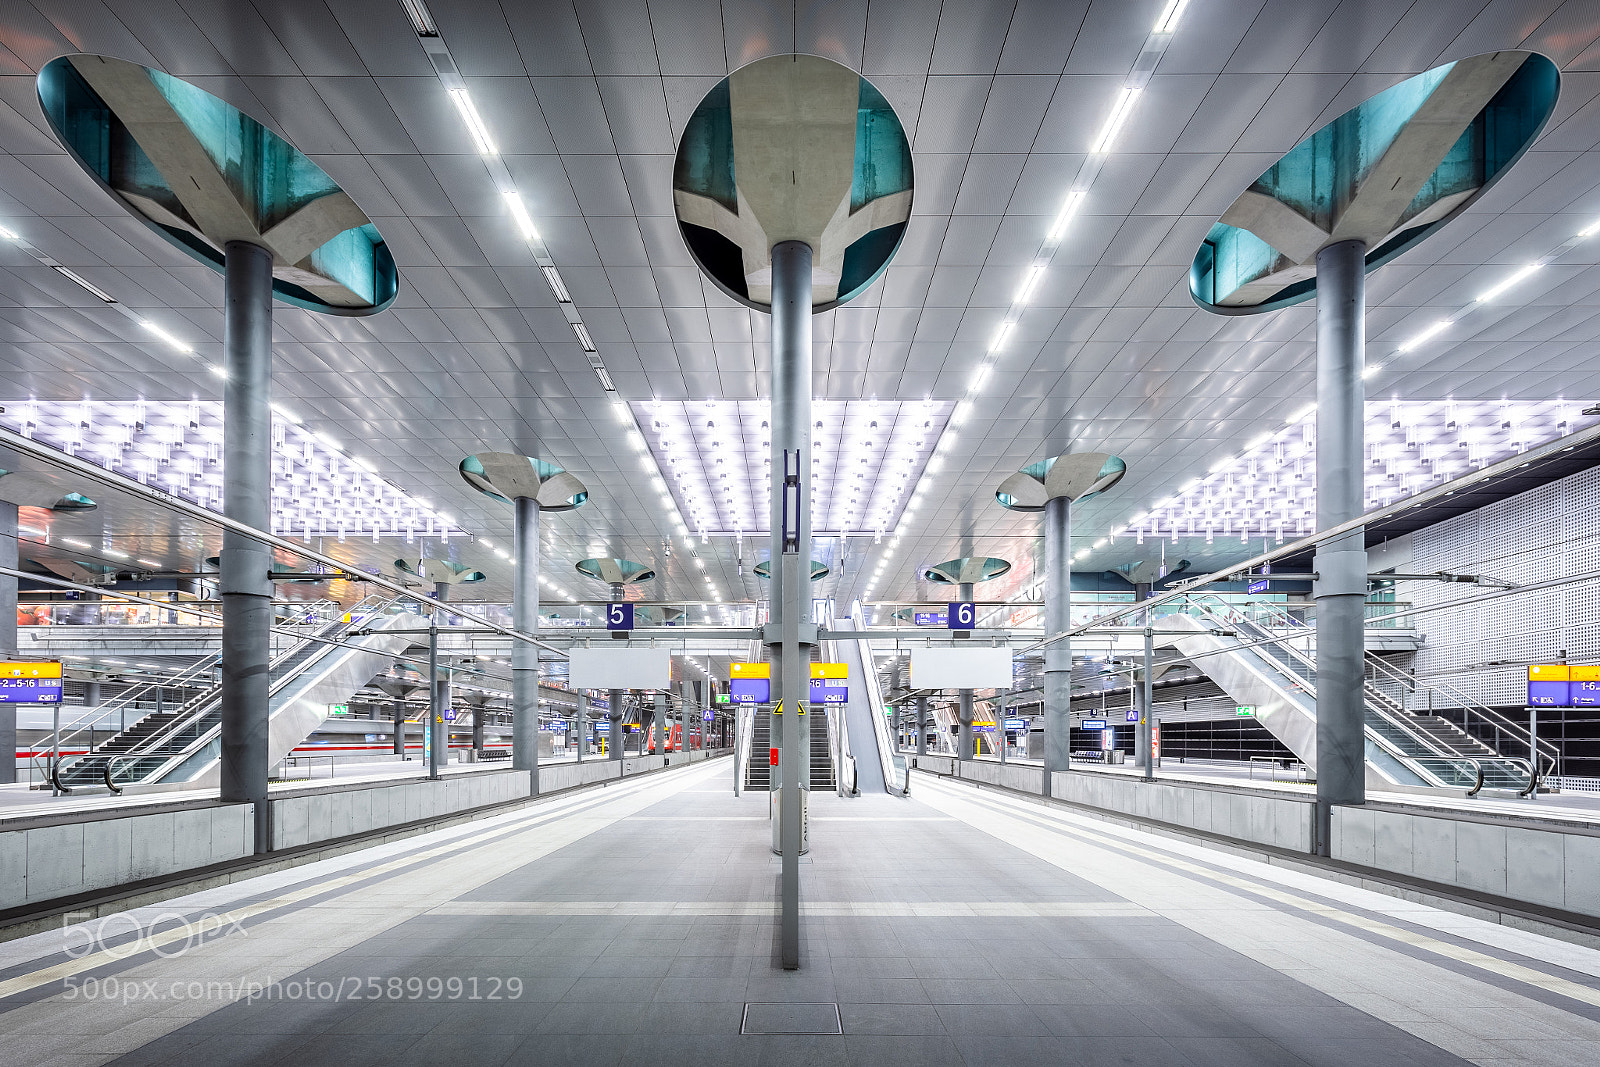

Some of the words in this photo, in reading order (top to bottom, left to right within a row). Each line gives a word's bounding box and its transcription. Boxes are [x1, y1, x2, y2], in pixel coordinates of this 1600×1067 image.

[611, 604, 624, 624] 5
[958, 604, 972, 624] 6
[16, 679, 35, 687] 5-16
[447, 710, 455, 719] A
[703, 710, 712, 719] A
[1127, 711, 1136, 720] A
